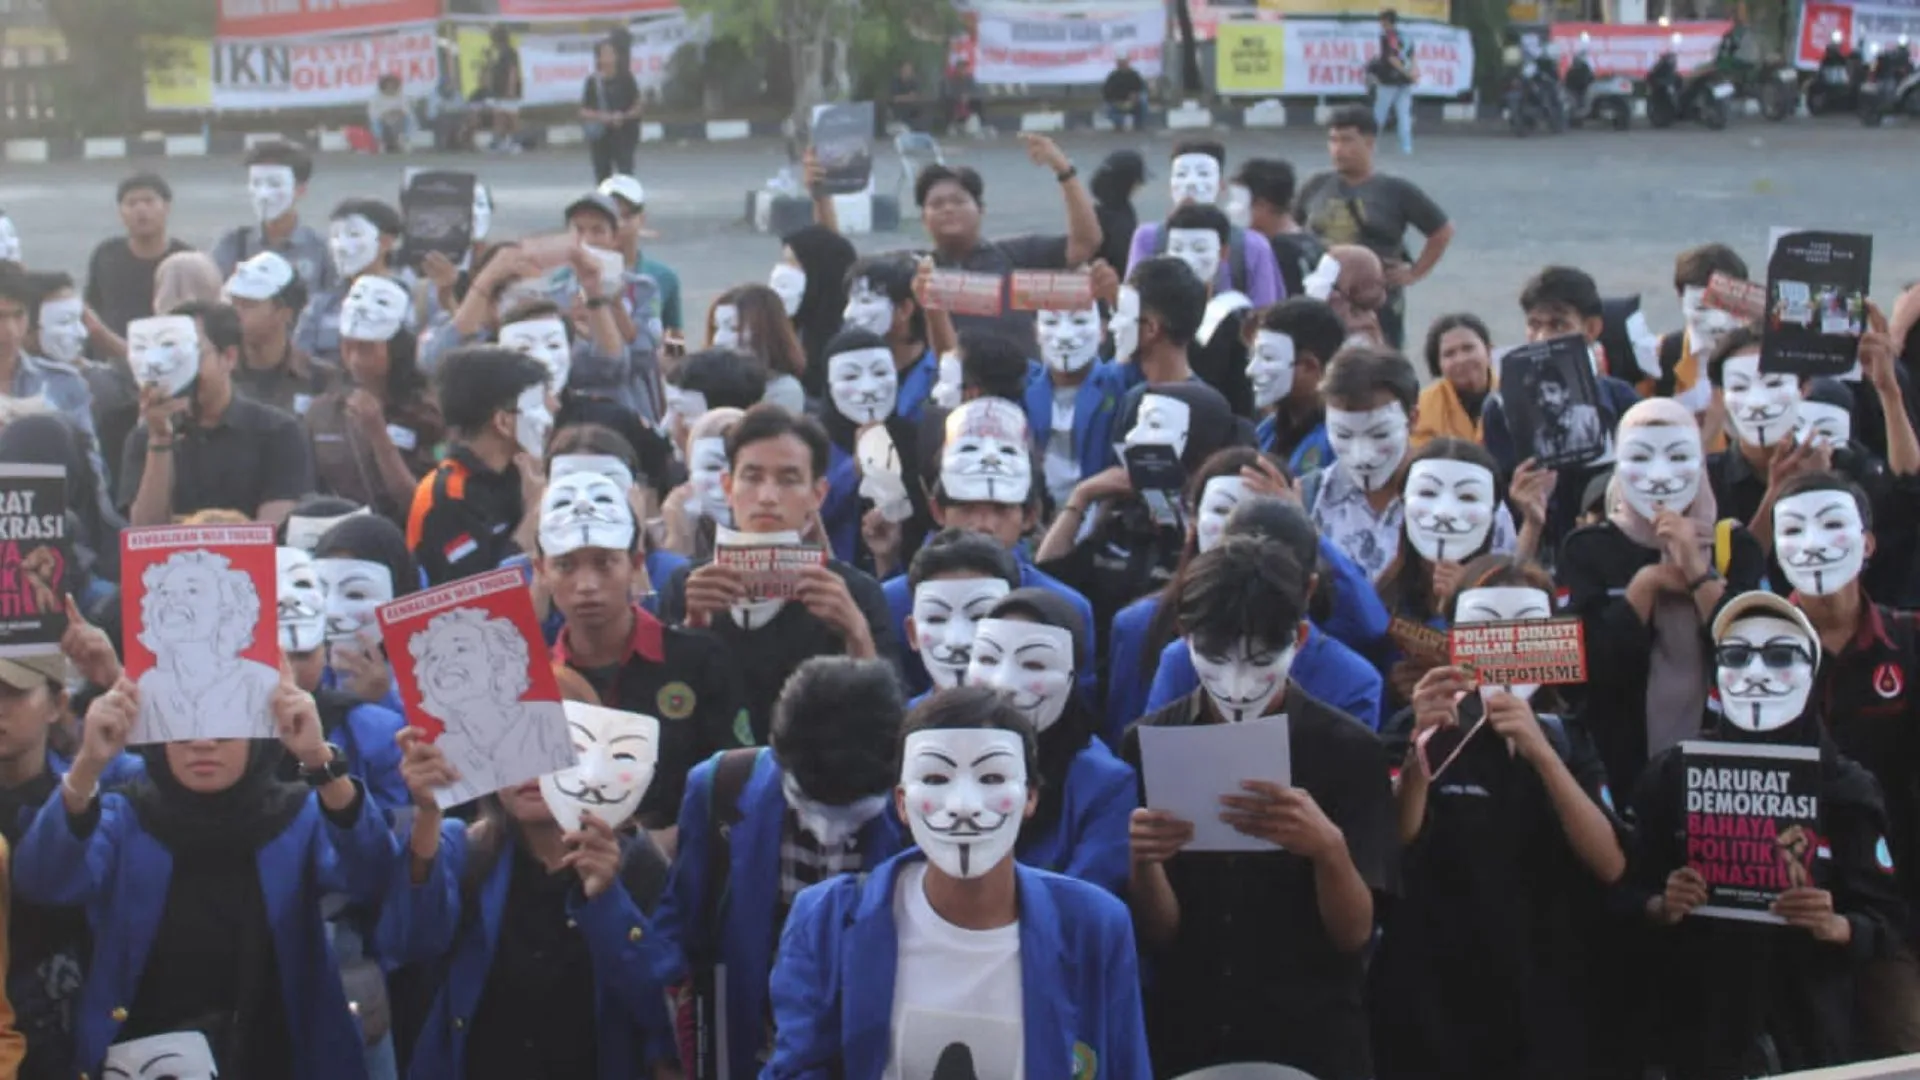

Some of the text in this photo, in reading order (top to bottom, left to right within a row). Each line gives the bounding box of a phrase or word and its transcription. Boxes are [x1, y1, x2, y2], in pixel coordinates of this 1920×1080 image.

[213, 44, 290, 85] IKN
[1454, 627, 1512, 644] POLITIK
[1519, 624, 1578, 640] DINASTI
[1455, 639, 1578, 656] ADALAH SUMBER
[1483, 665, 1580, 683] NEPOTISME
[1687, 767, 1790, 793] DARURAT
[1687, 790, 1817, 819] DEMOKRASI
[1687, 813, 1777, 838] BAHAYA
[1687, 836, 1774, 863] POLITIK
